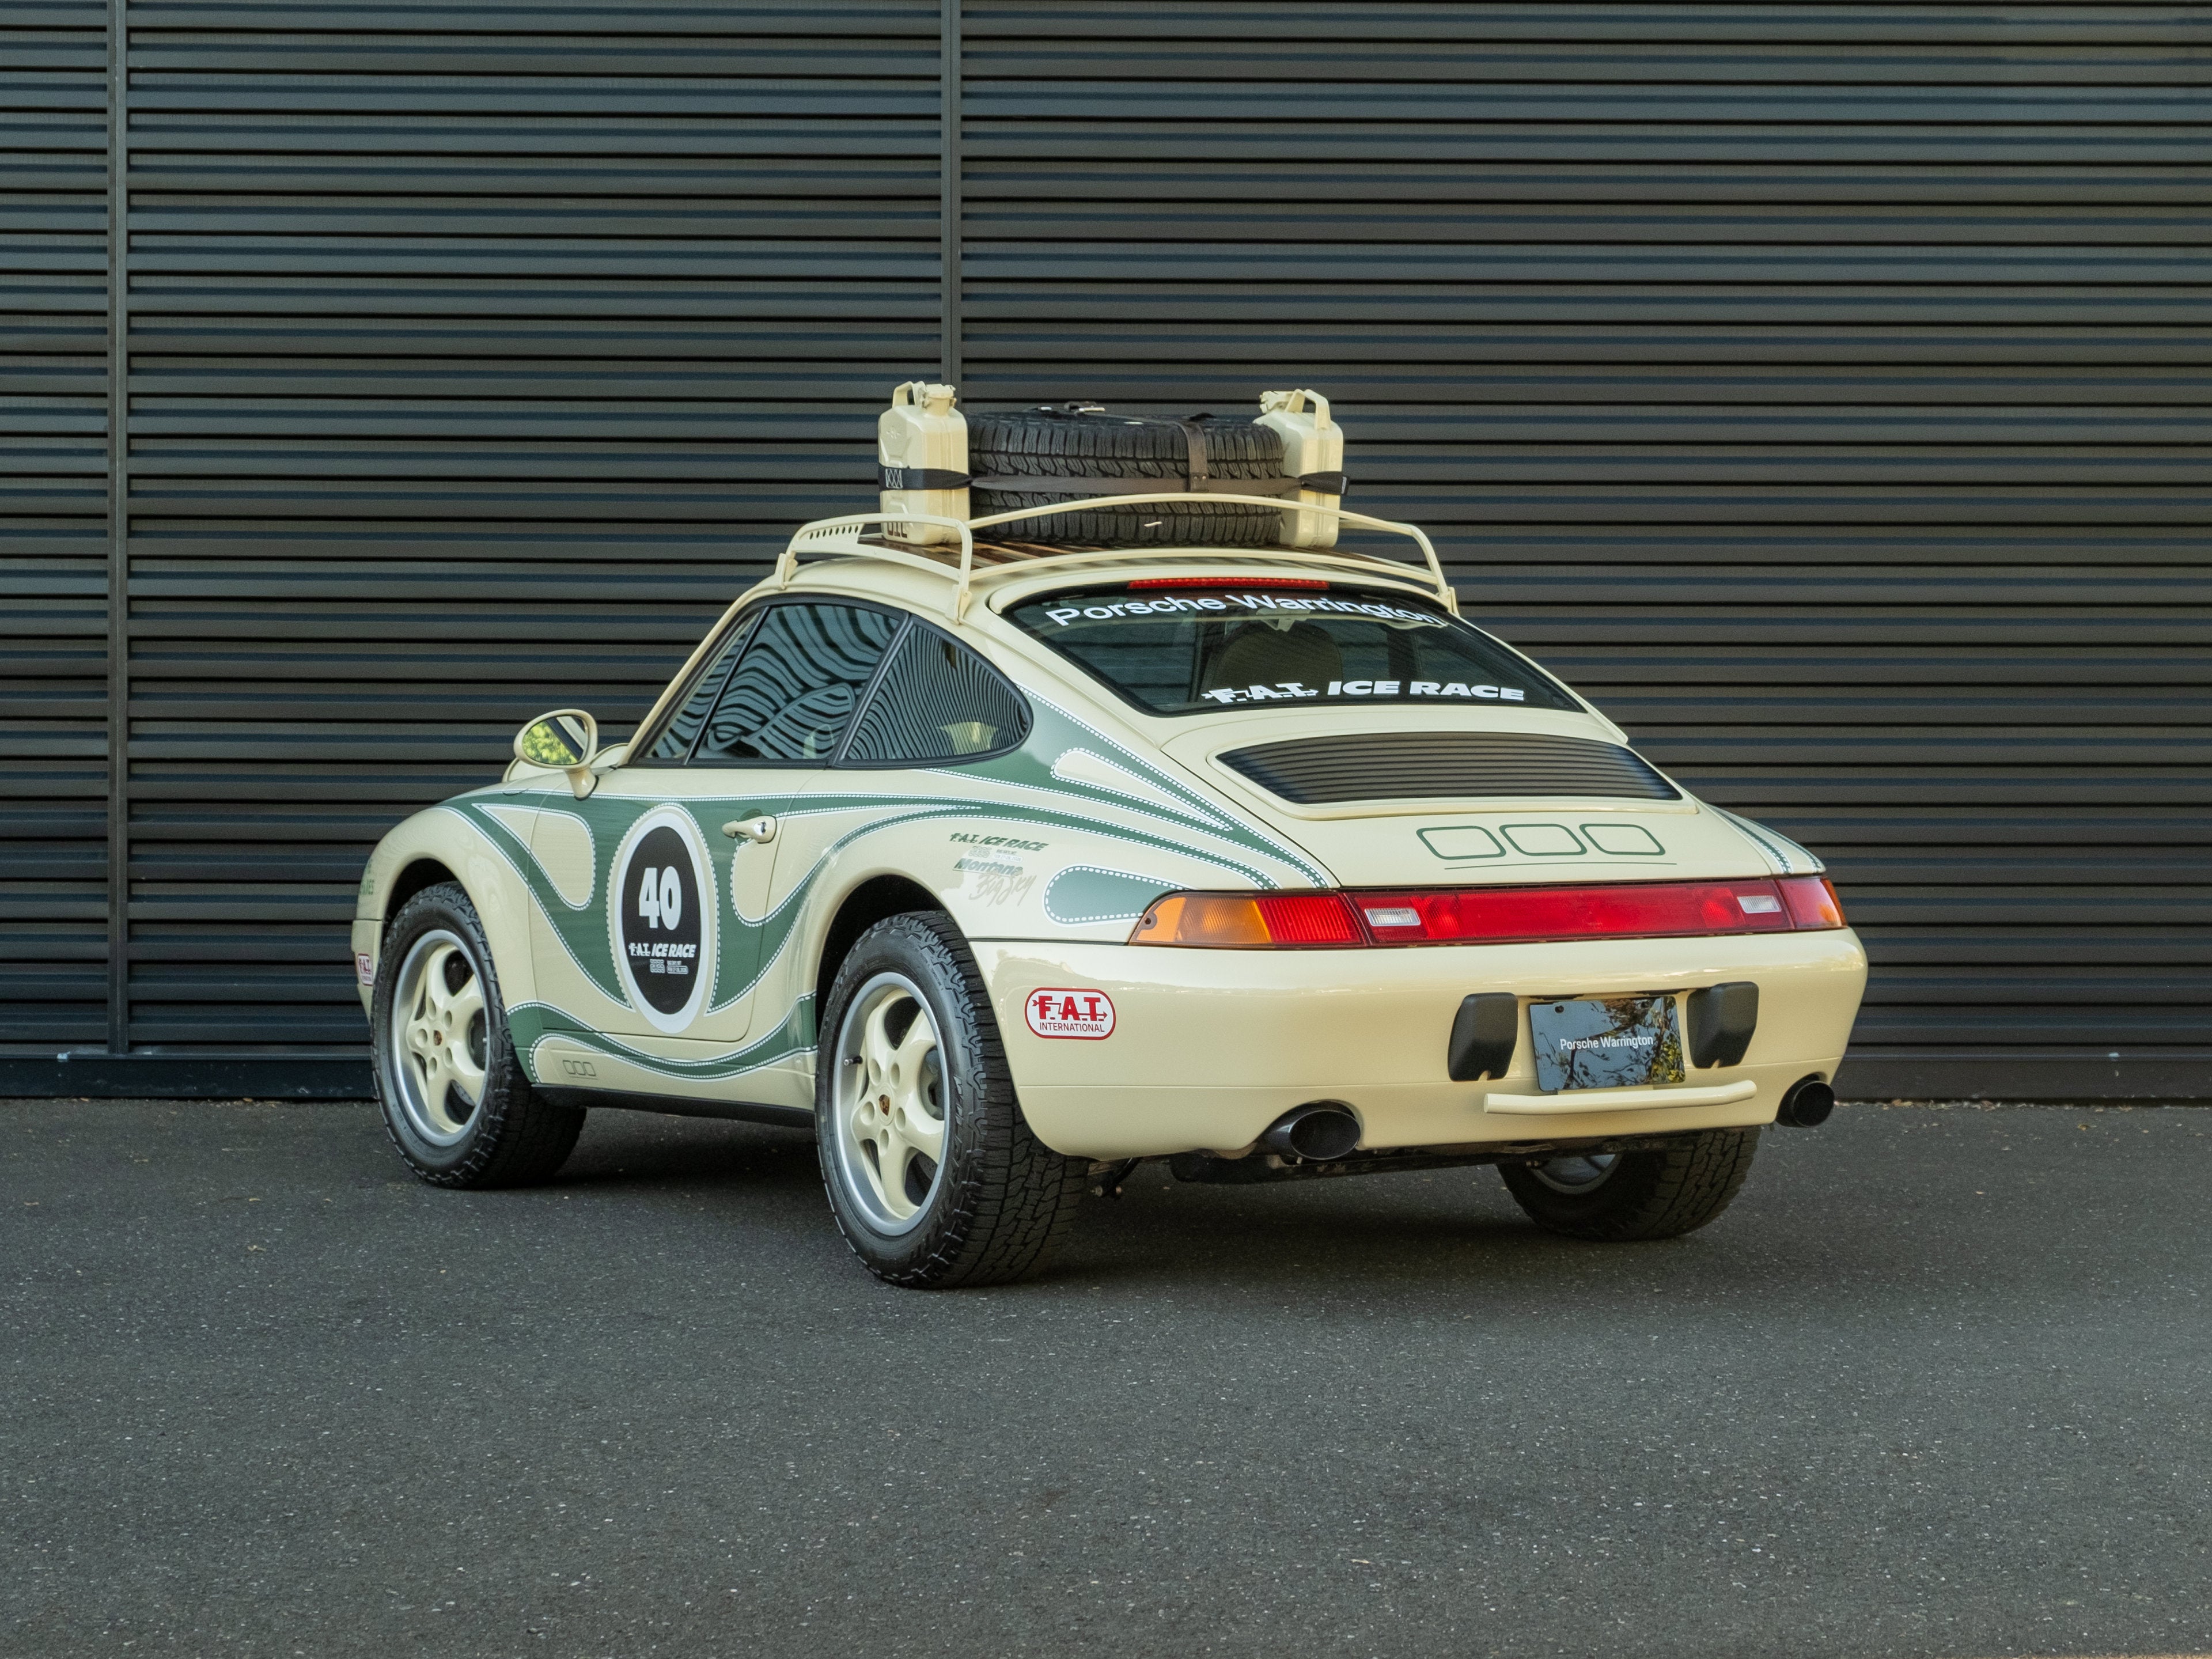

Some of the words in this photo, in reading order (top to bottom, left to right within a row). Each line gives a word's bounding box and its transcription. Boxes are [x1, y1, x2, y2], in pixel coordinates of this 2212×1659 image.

[1046, 596, 1226, 627] Porsche
[1225, 594, 1448, 627] Warrington
[1327, 680, 1400, 695] ICE
[1410, 681, 1524, 701] RACE
[978, 836, 1009, 846] ICE
[1002, 839, 1050, 851] RACE
[954, 858, 1024, 876] Montana
[639, 866, 681, 930] 40
[651, 943, 669, 957] ICE
[668, 944, 696, 958] RACE
[1039, 1022, 1105, 1032] INTERNATIONAL
[1560, 1038, 1599, 1050] Porsche
[1600, 1036, 1654, 1049] Warrington
